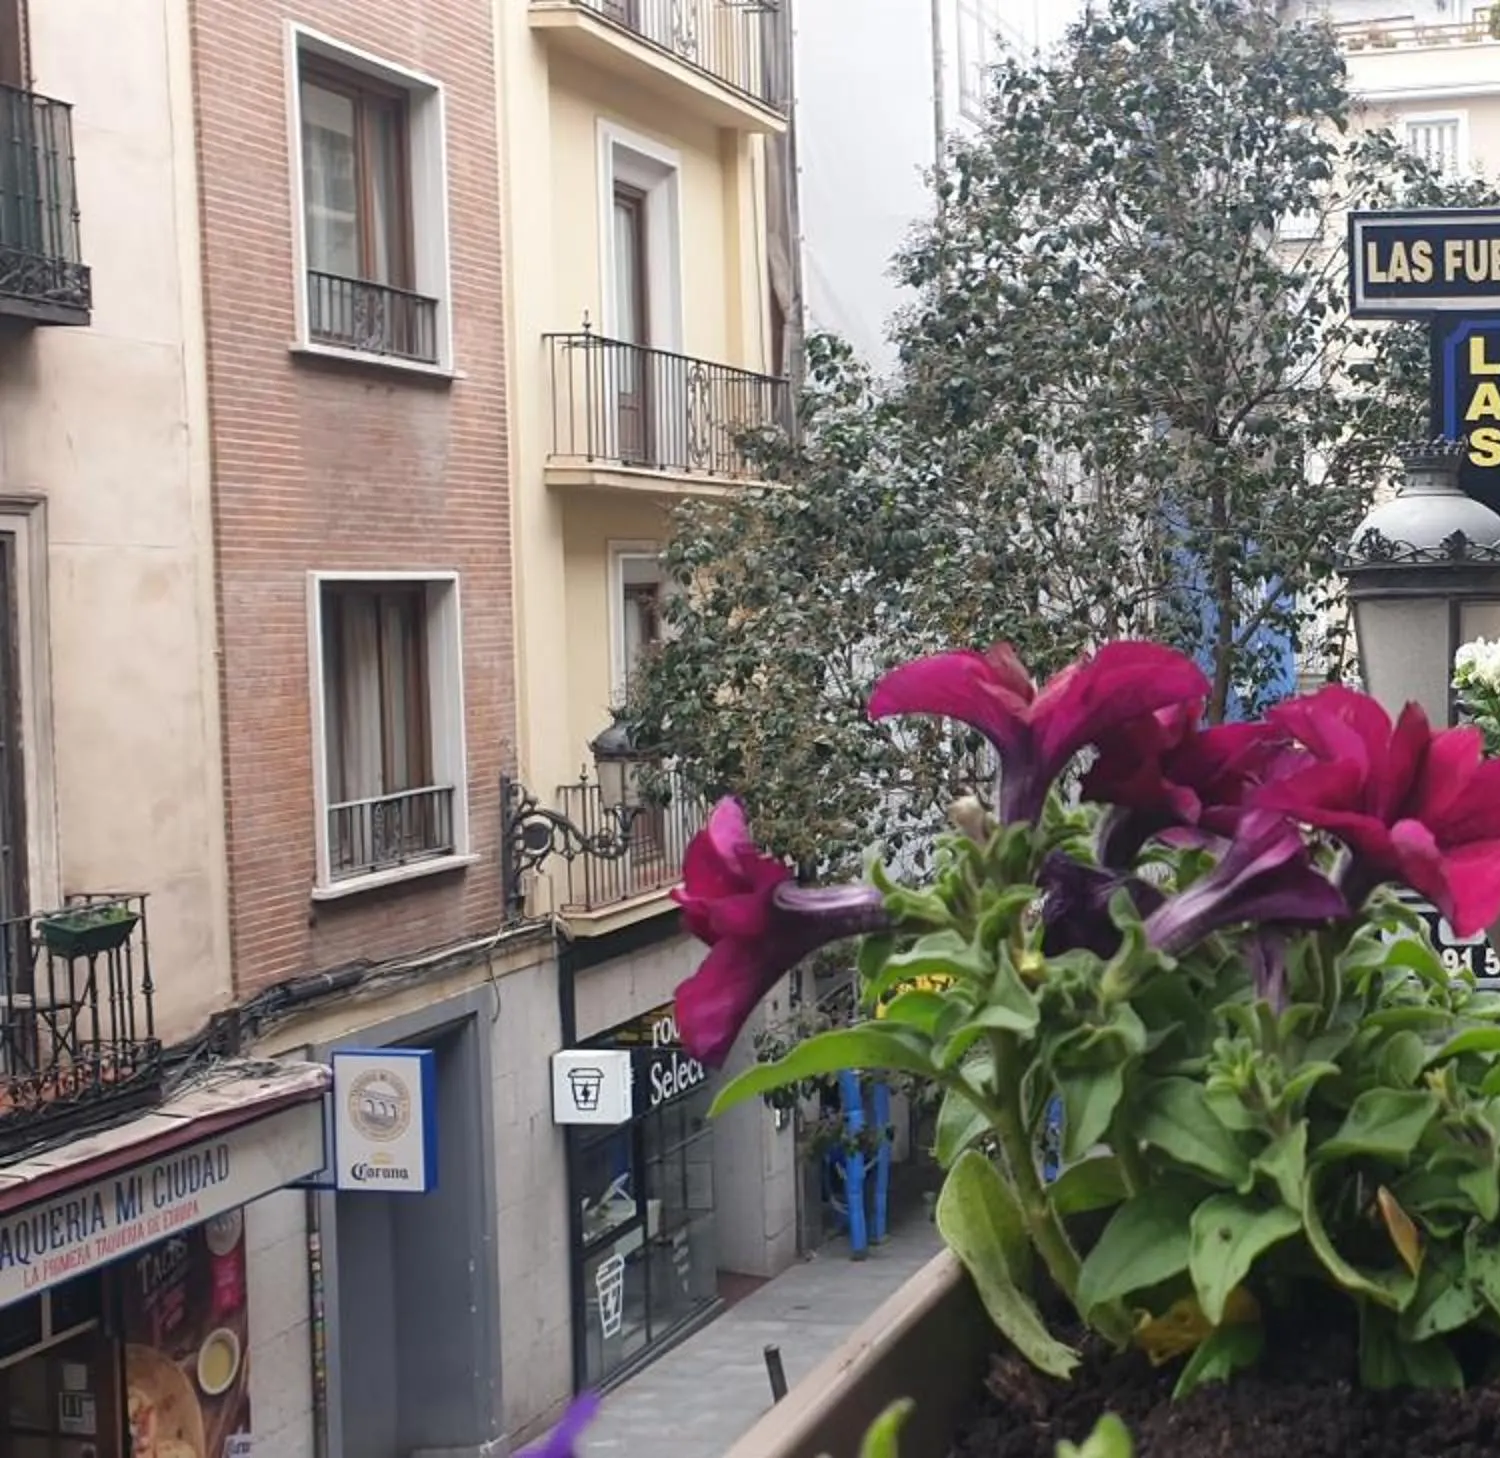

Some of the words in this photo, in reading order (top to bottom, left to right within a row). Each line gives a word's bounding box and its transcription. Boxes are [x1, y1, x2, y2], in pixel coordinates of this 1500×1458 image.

[1367, 239, 1433, 283] LAS
[1442, 946, 1473, 975] 91
[114, 1176, 143, 1225] MI
[152, 1143, 229, 1208] CIUDAD
[351, 1162, 409, 1182] Corona
[23, 1266, 39, 1289] LA
[43, 1243, 91, 1281] PRIMERA
[163, 1199, 199, 1229] EUROPA
